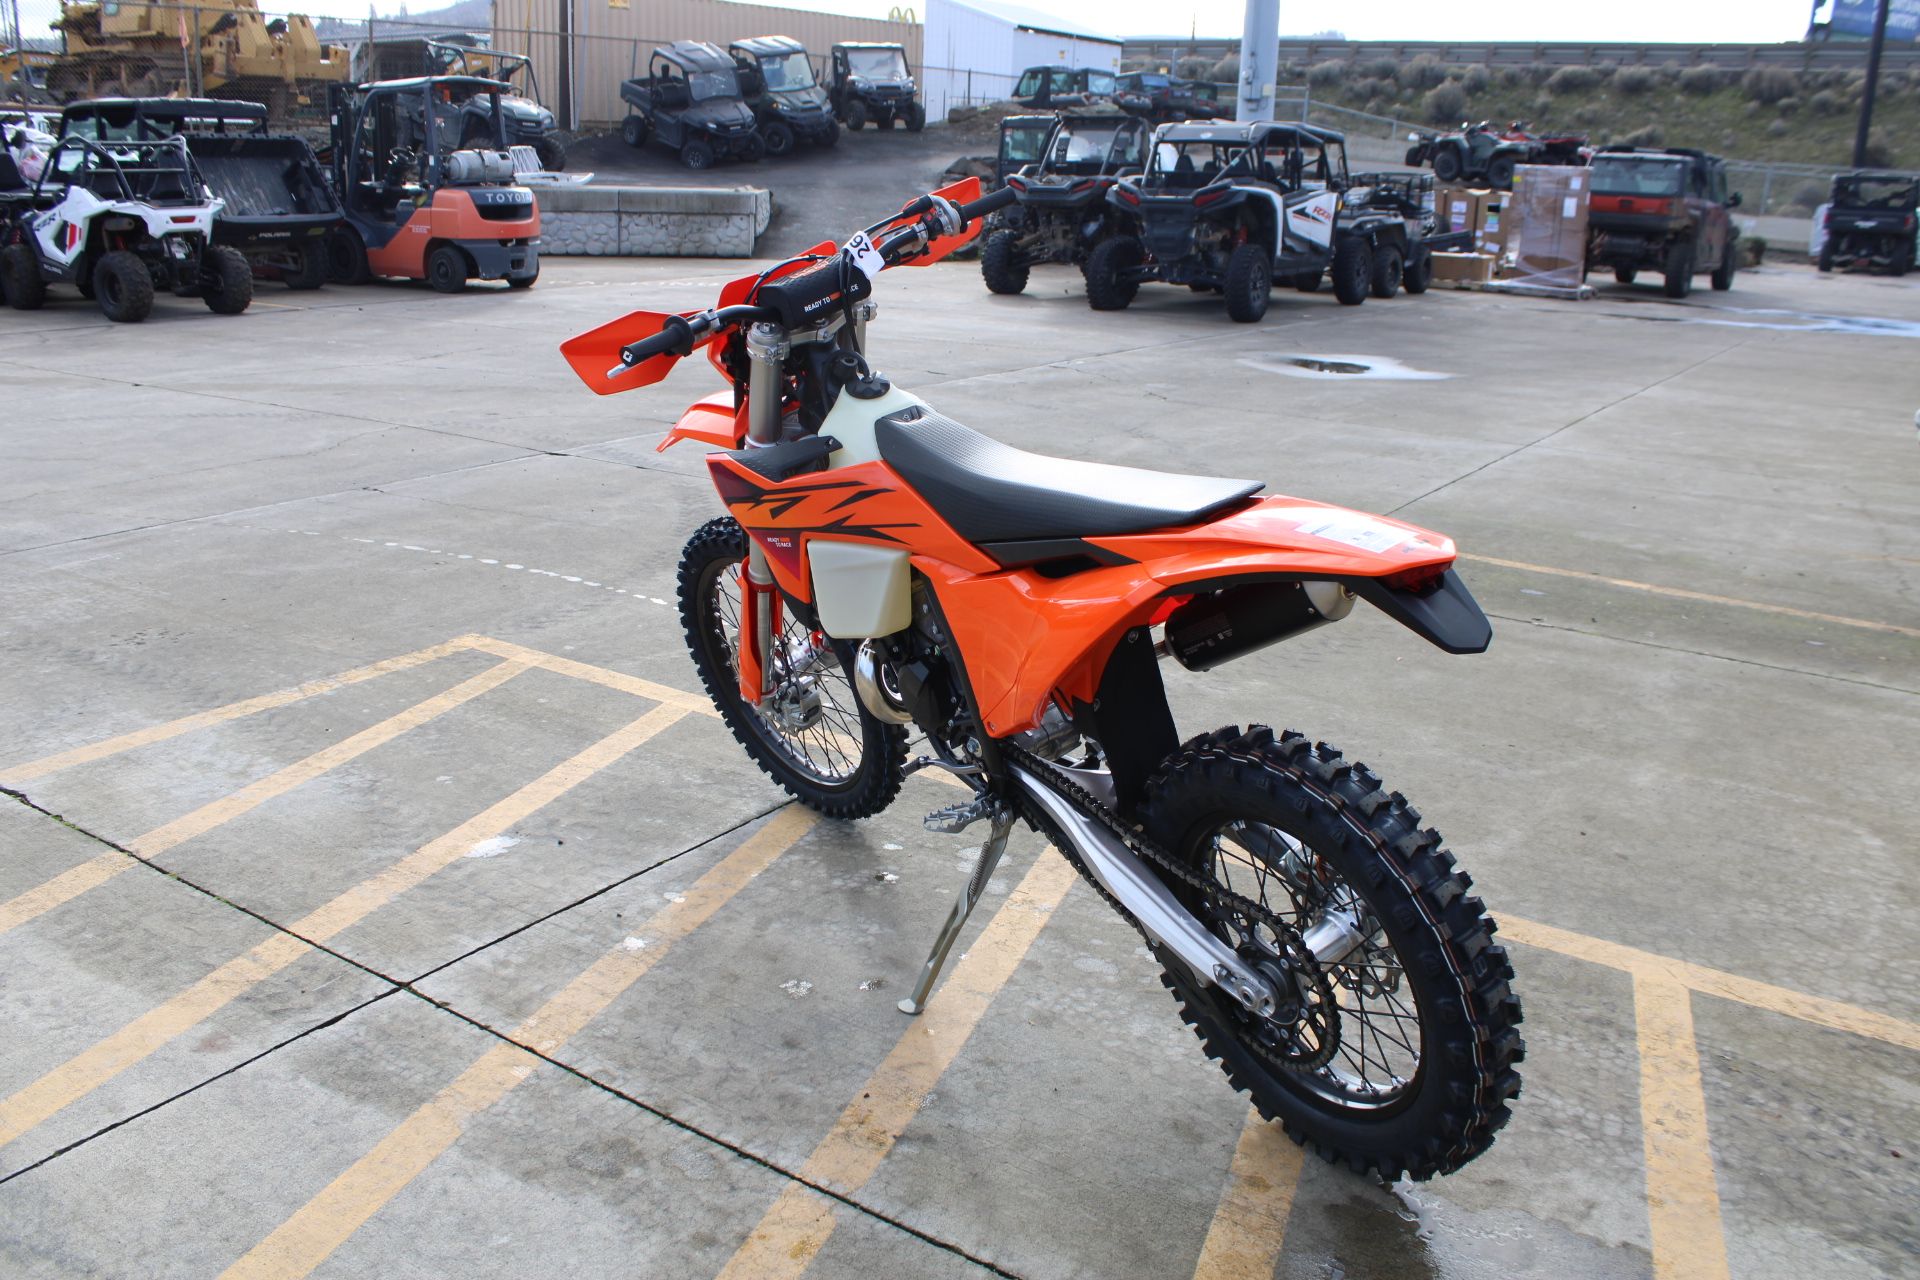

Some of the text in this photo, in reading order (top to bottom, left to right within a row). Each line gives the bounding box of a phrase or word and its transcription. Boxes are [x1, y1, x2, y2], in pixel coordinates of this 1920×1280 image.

[849, 234, 871, 259] 26
[804, 300, 822, 312] READY
[822, 296, 831, 305] TO
